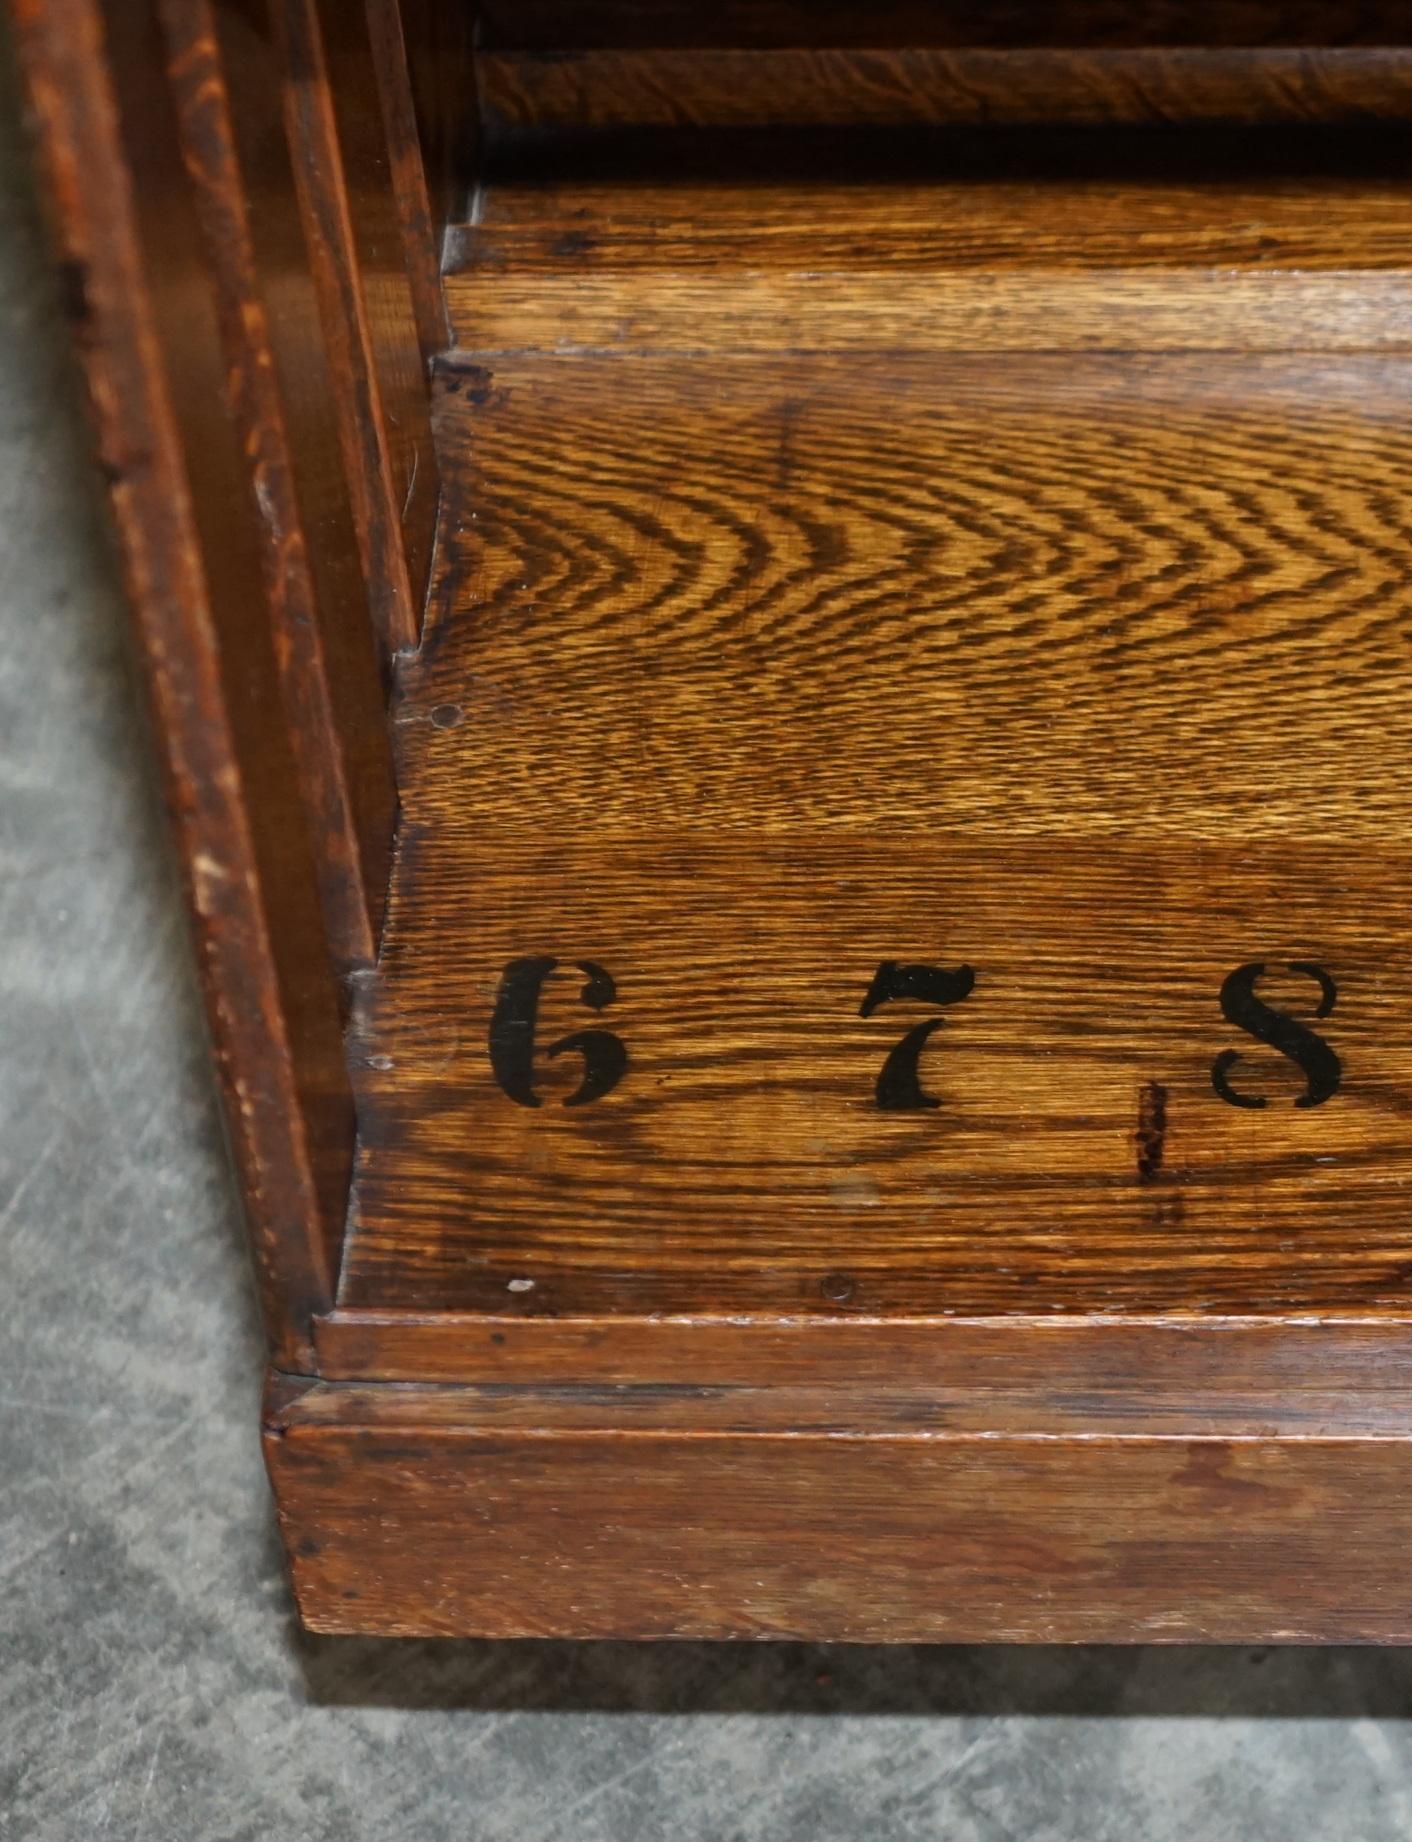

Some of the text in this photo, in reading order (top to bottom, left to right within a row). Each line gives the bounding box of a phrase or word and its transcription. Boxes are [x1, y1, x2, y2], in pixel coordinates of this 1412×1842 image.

[488, 956, 629, 1108] 6
[858, 960, 976, 1109] 7
[1211, 961, 1343, 1108] 8
